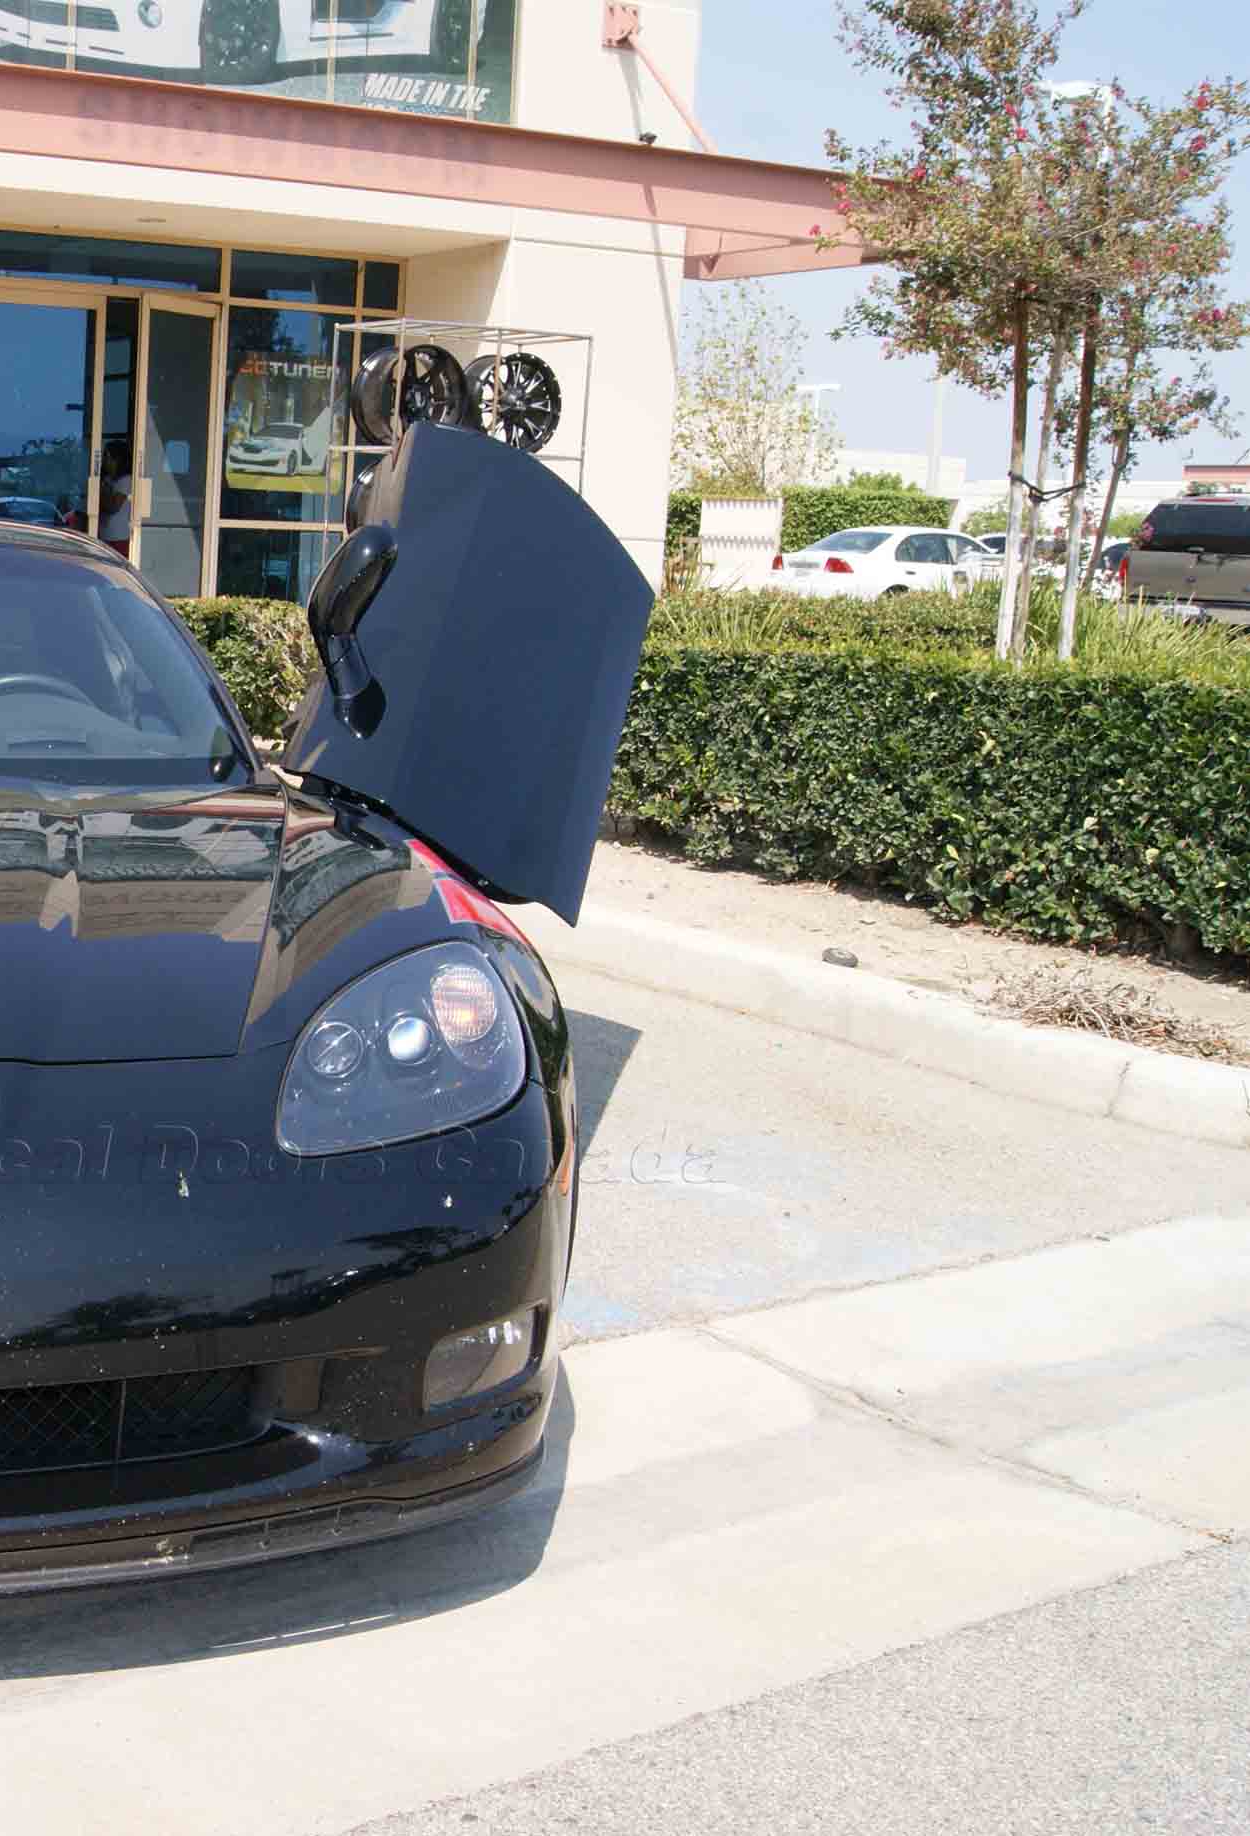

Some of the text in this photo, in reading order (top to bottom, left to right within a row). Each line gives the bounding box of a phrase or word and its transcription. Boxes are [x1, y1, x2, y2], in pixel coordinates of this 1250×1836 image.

[364, 73, 425, 103] MADE
[421, 80, 451, 106] IN
[449, 83, 491, 112] THE
